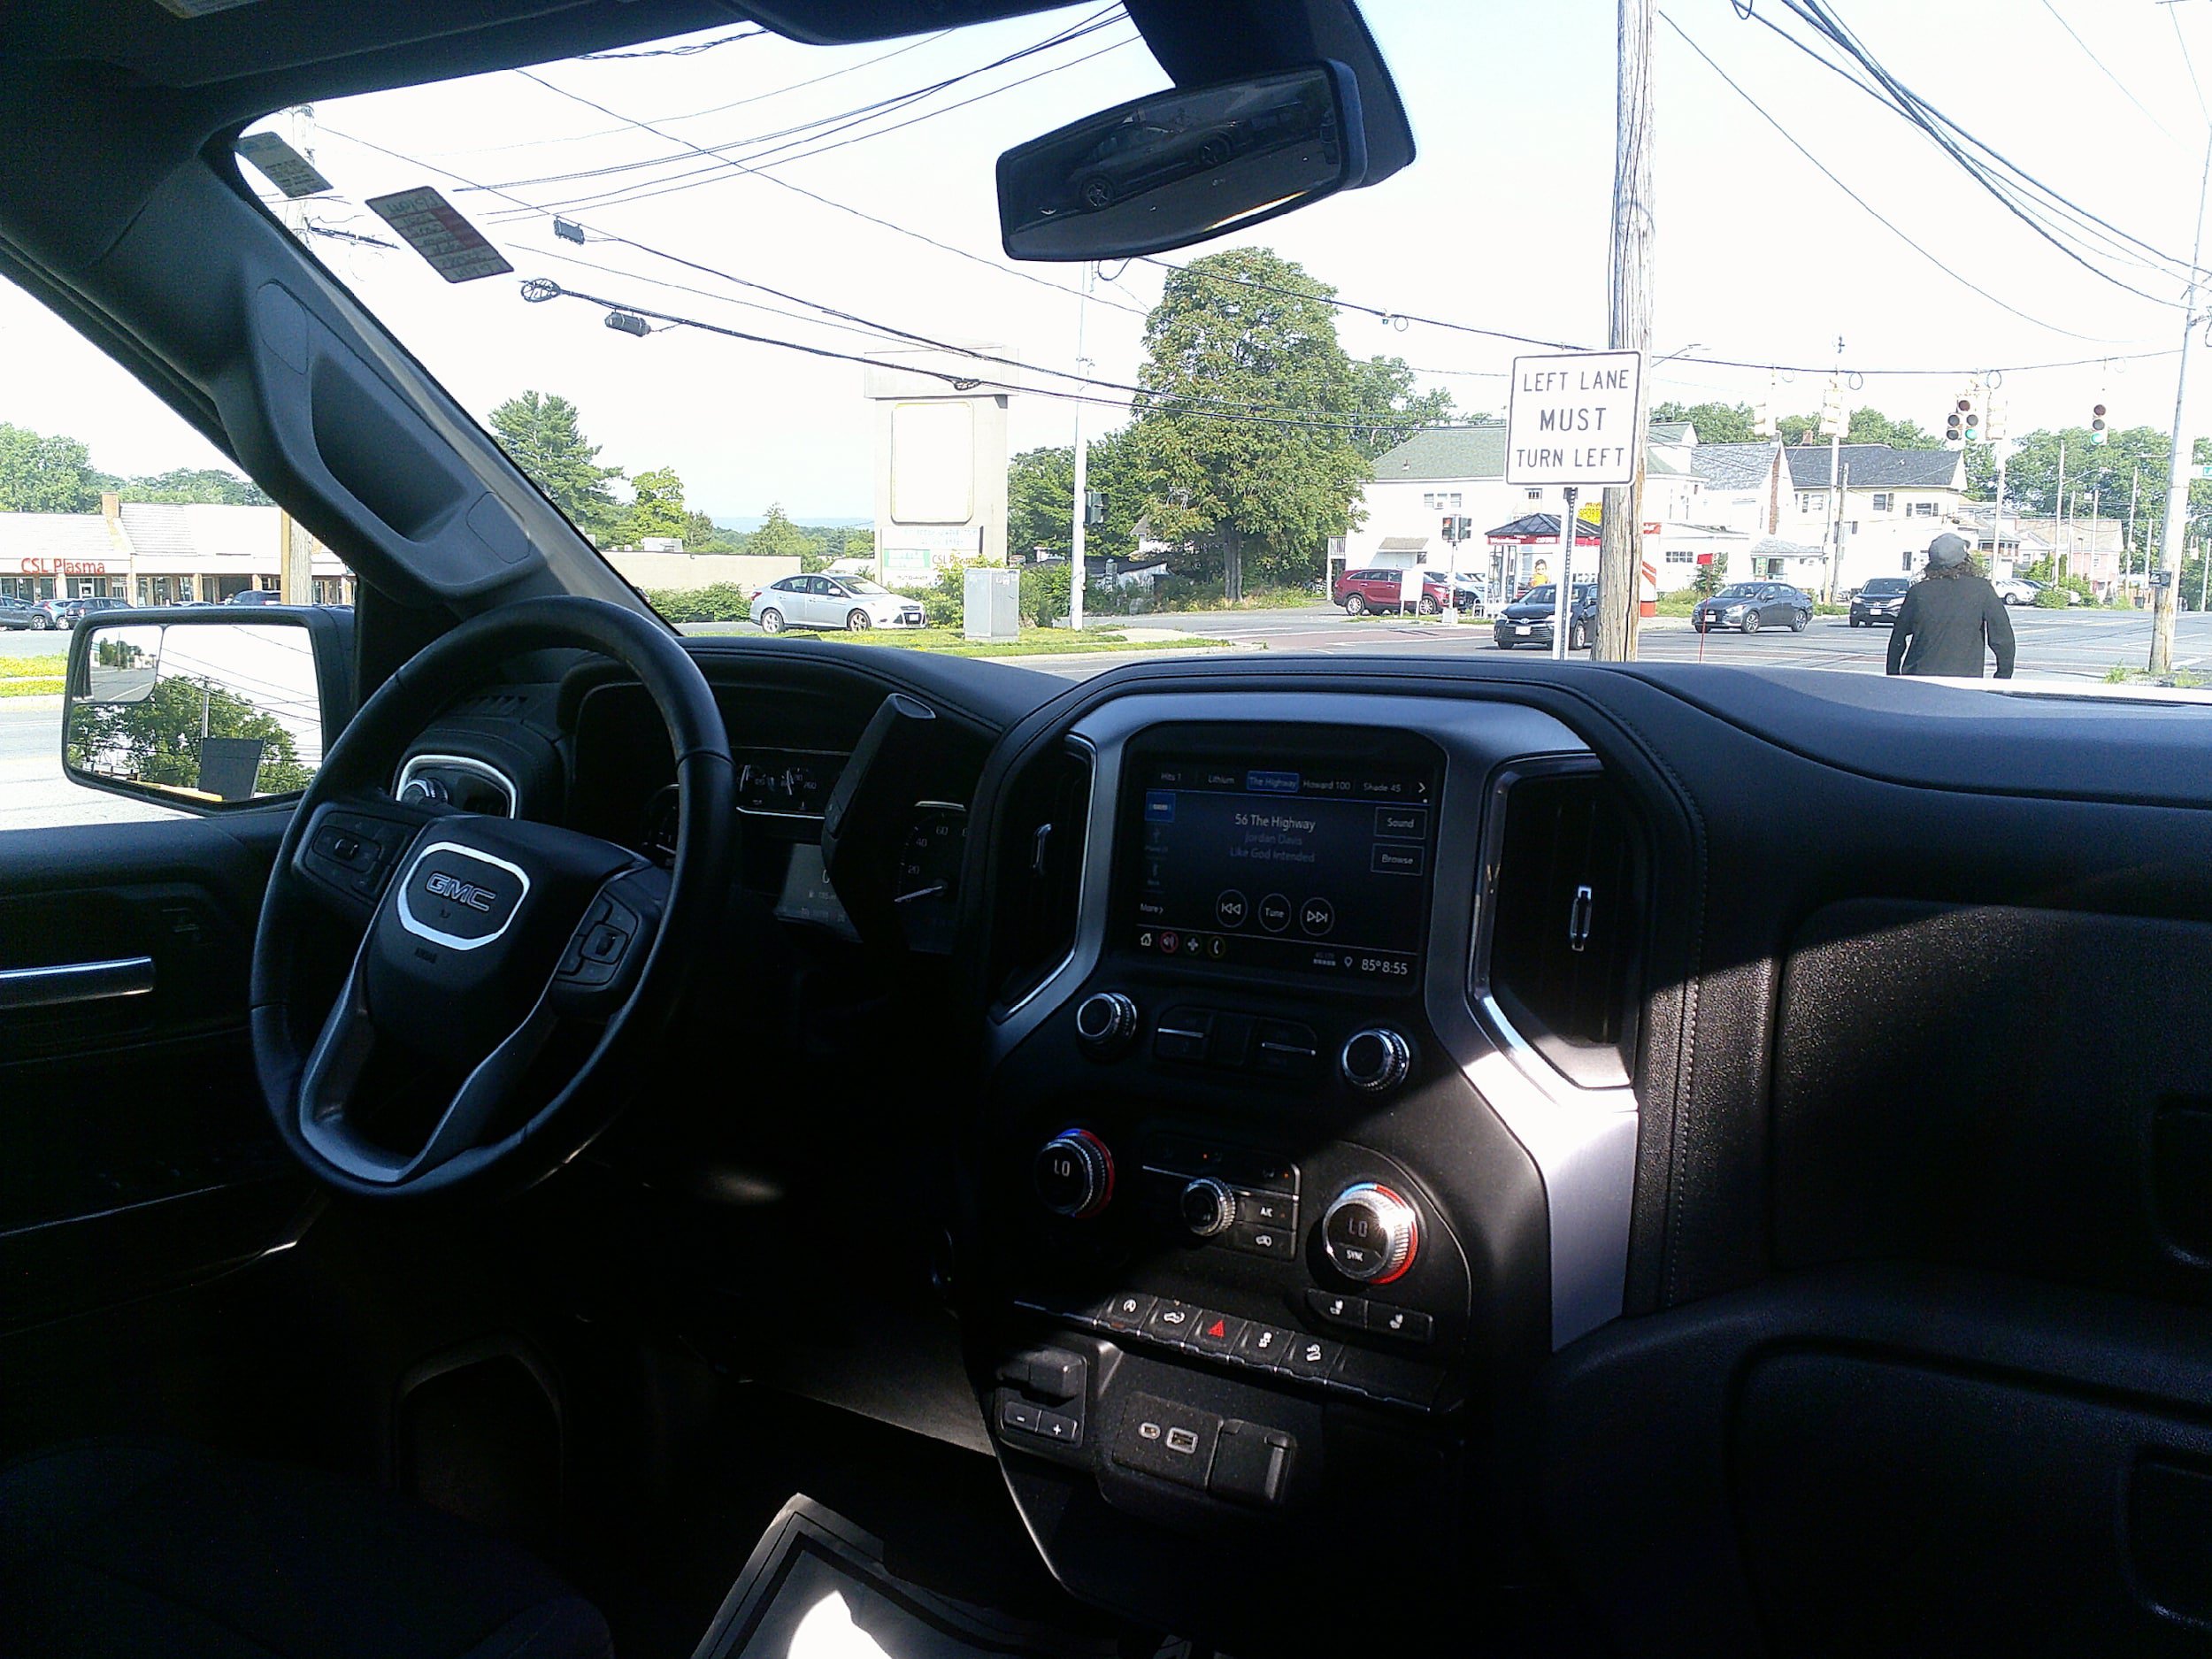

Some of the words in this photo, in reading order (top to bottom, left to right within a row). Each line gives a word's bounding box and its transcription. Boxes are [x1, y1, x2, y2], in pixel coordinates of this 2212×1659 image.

[1524, 372, 1569, 392] LEFT
[1580, 369, 1629, 390] LANE
[1540, 407, 1607, 432] MUST
[1517, 449, 1563, 468] TURN
[1574, 448, 1624, 467] LEFT
[21, 557, 49, 574] CSL
[53, 557, 105, 574] Plasma
[932, 554, 947, 565] CSL
[1207, 774, 1235, 786] Lithium
[1265, 777, 1297, 789] Highway
[1335, 780, 1351, 791] 100
[1234, 813, 1248, 826] 56
[1250, 814, 1271, 828] The
[1271, 815, 1317, 833] Highway
[1386, 818, 1415, 828] Sound
[935, 826, 949, 836] 60
[916, 837, 927, 848] 40
[1250, 848, 1271, 860] God
[1381, 854, 1414, 865] Browse
[907, 864, 920, 875] 20
[425, 872, 496, 912] GMC
[1265, 907, 1285, 918] Tune
[1381, 961, 1409, 976] 8:55
[1054, 1158, 1071, 1178] LO
[1348, 1217, 1368, 1238] LO
[1346, 1249, 1363, 1263] SYNC
